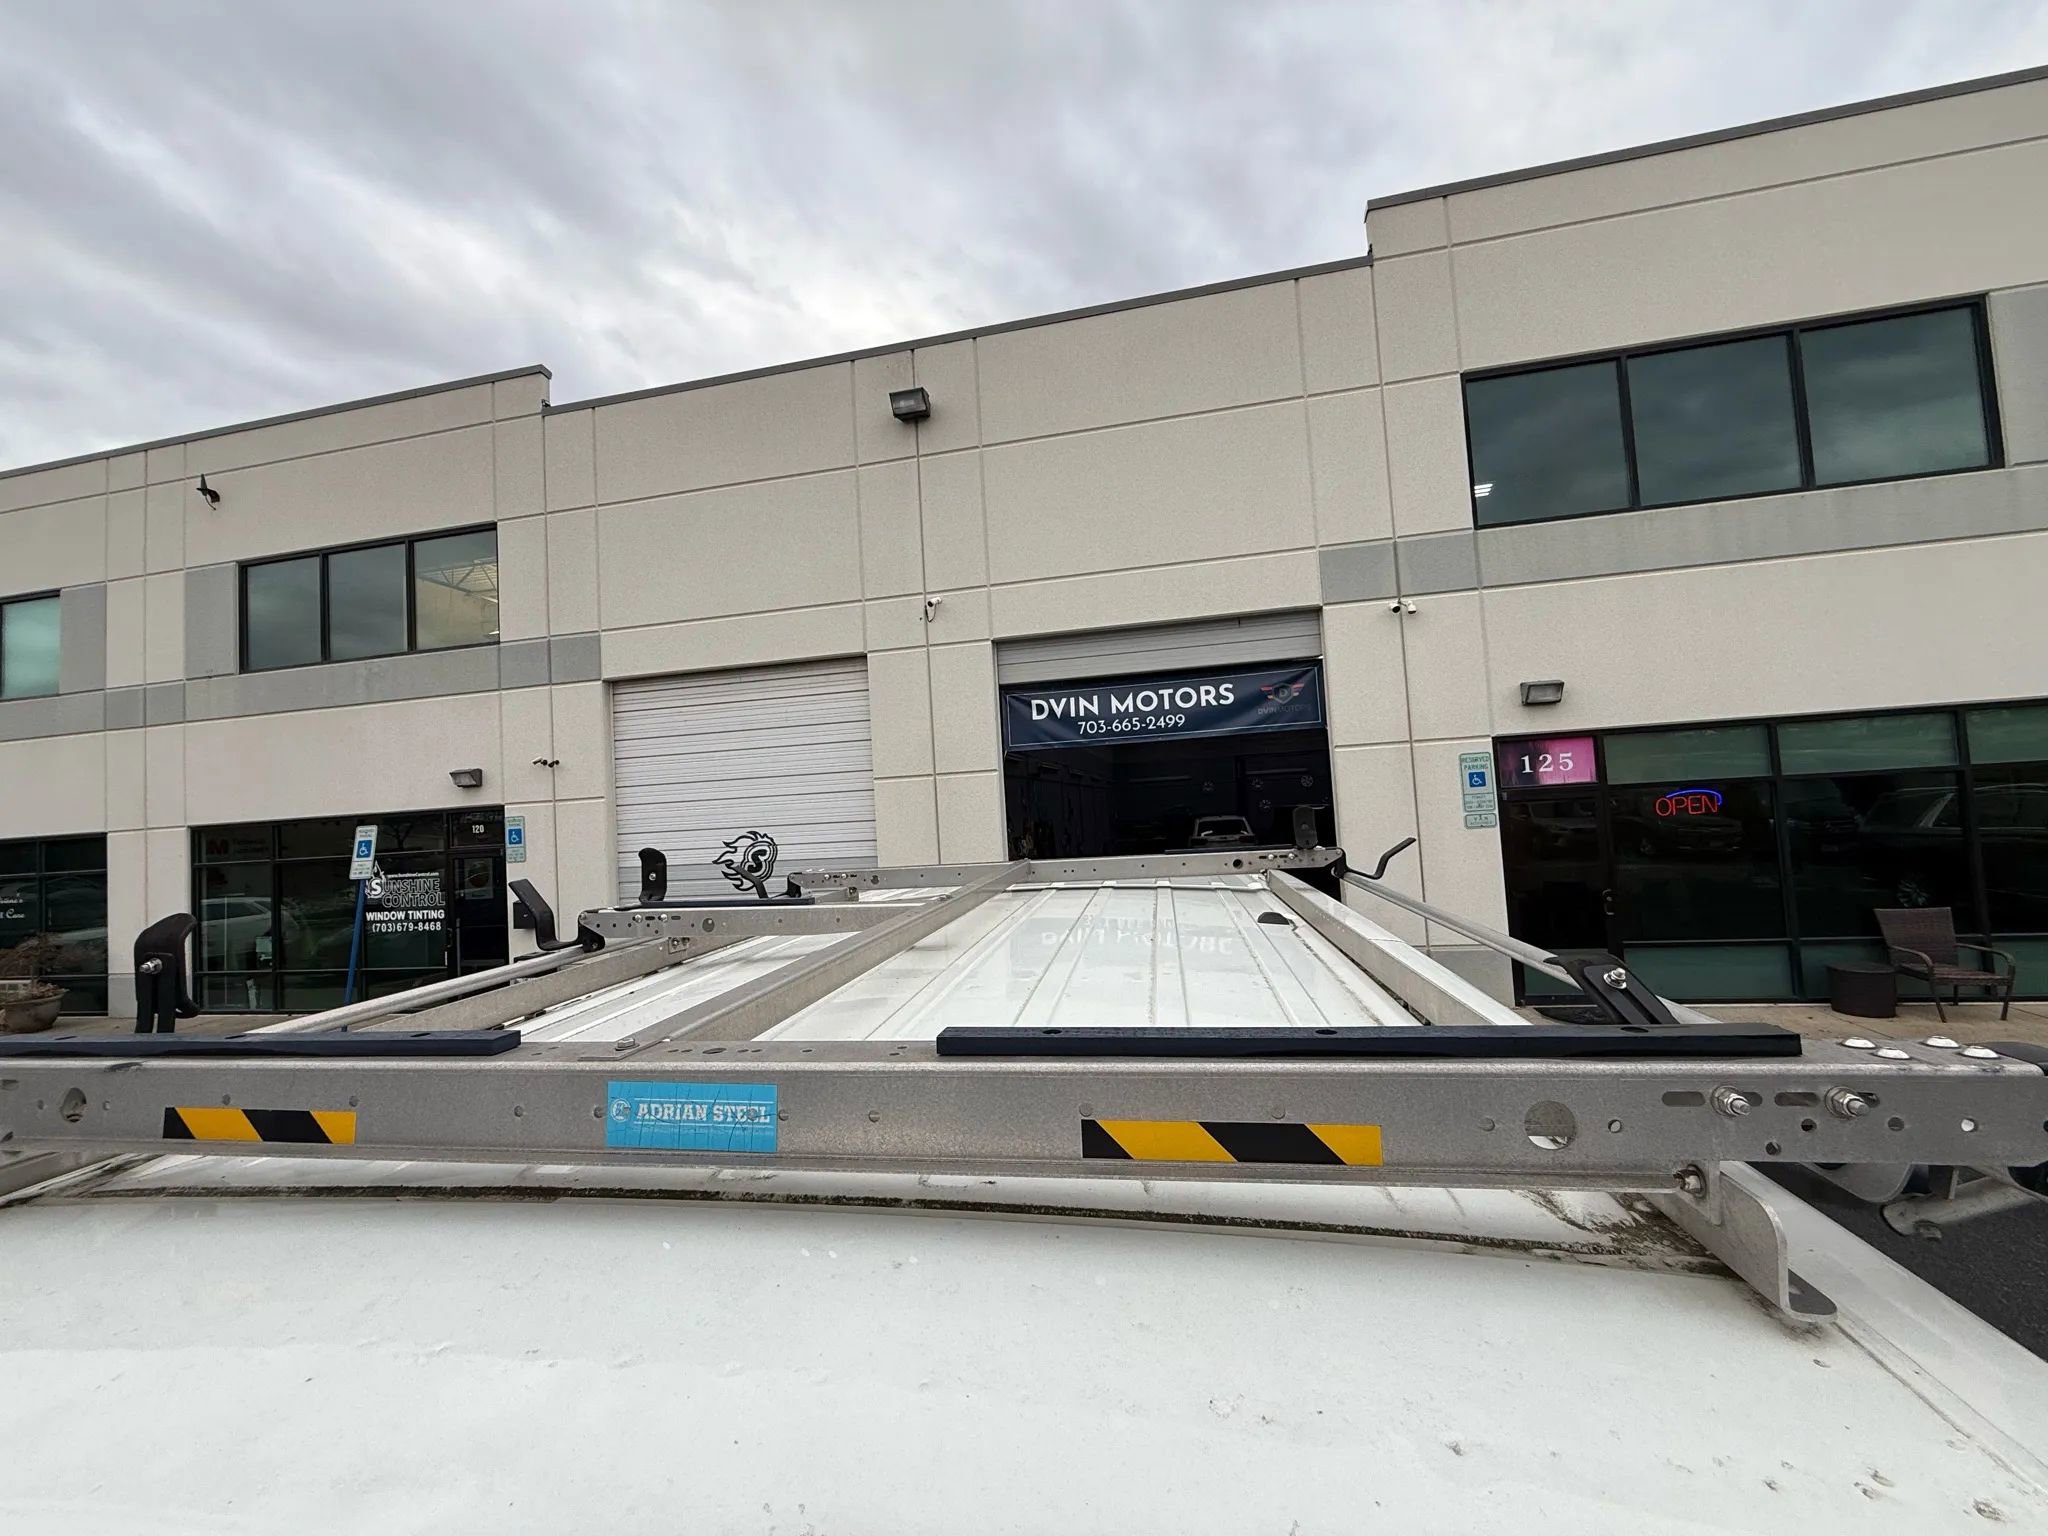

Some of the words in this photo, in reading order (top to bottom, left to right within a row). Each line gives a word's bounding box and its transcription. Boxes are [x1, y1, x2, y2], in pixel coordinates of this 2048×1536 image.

[1031, 696, 1098, 720] DVIN
[1111, 684, 1234, 713] MOTORS
[1078, 714, 1185, 734] 703-665-2499
[1521, 753, 1574, 773] 125
[1655, 796, 1718, 817] OPEN
[472, 825, 485, 833] 120
[371, 878, 440, 895] SUNSHINE
[382, 892, 446, 907] CONTROL
[365, 911, 406, 921] WINDOW
[407, 909, 445, 920] TINTING
[372, 921, 442, 932] (703)679-8468
